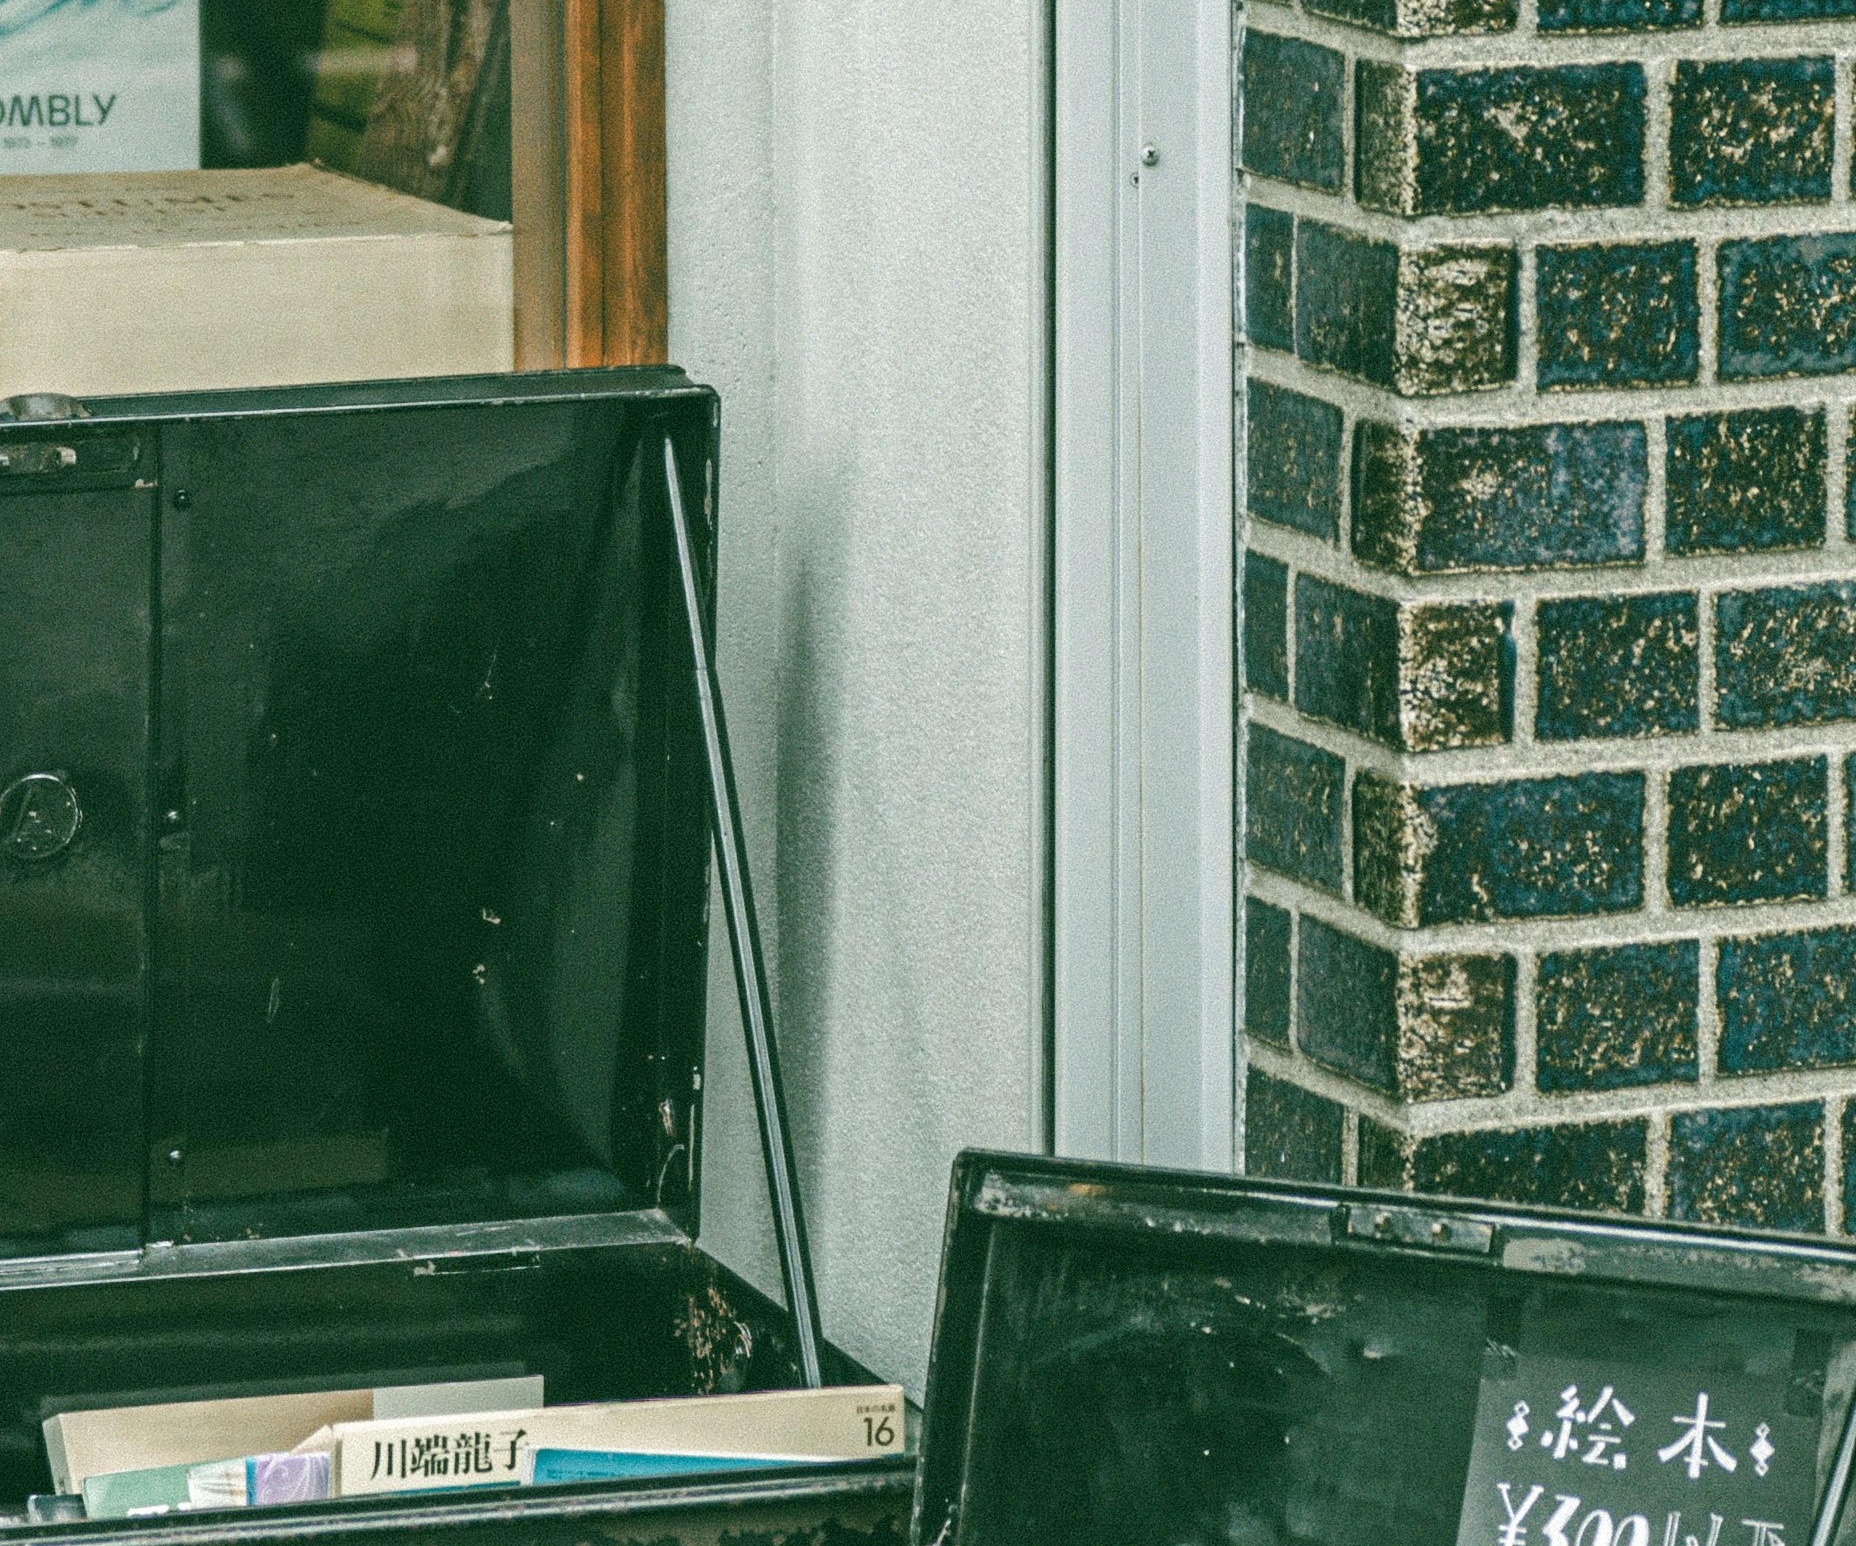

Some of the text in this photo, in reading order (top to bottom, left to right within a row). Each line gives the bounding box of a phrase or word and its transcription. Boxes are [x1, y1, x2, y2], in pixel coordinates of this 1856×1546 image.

[863, 1416, 895, 1447] 16
[370, 1428, 528, 1481] 川端龍子
